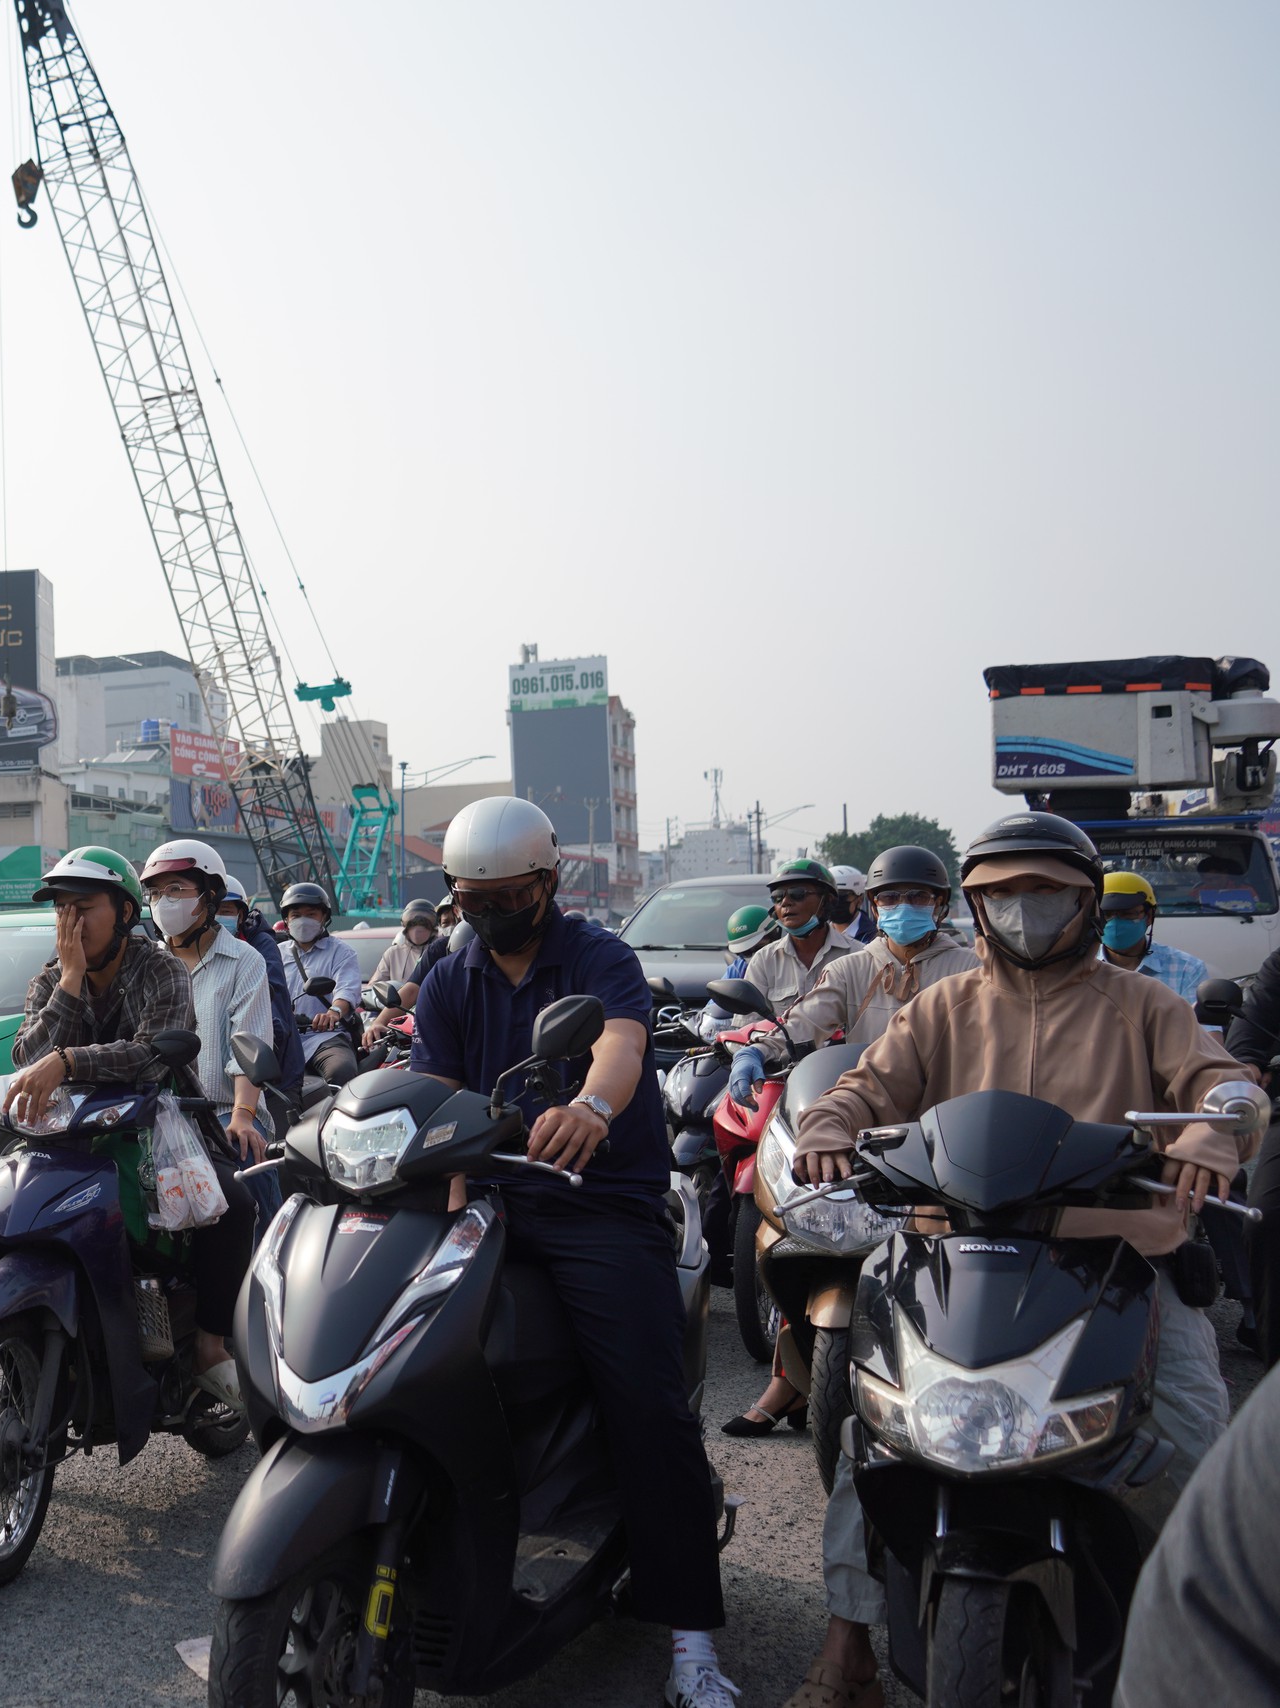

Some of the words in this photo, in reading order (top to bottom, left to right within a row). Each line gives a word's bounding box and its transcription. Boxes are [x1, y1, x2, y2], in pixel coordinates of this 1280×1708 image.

[512, 670, 604, 695] 0961.015.016
[997, 765, 1027, 776] DHT
[1032, 763, 1066, 775] 160S
[202, 784, 231, 817] Tiger
[959, 1243, 1020, 1254] HONDA
